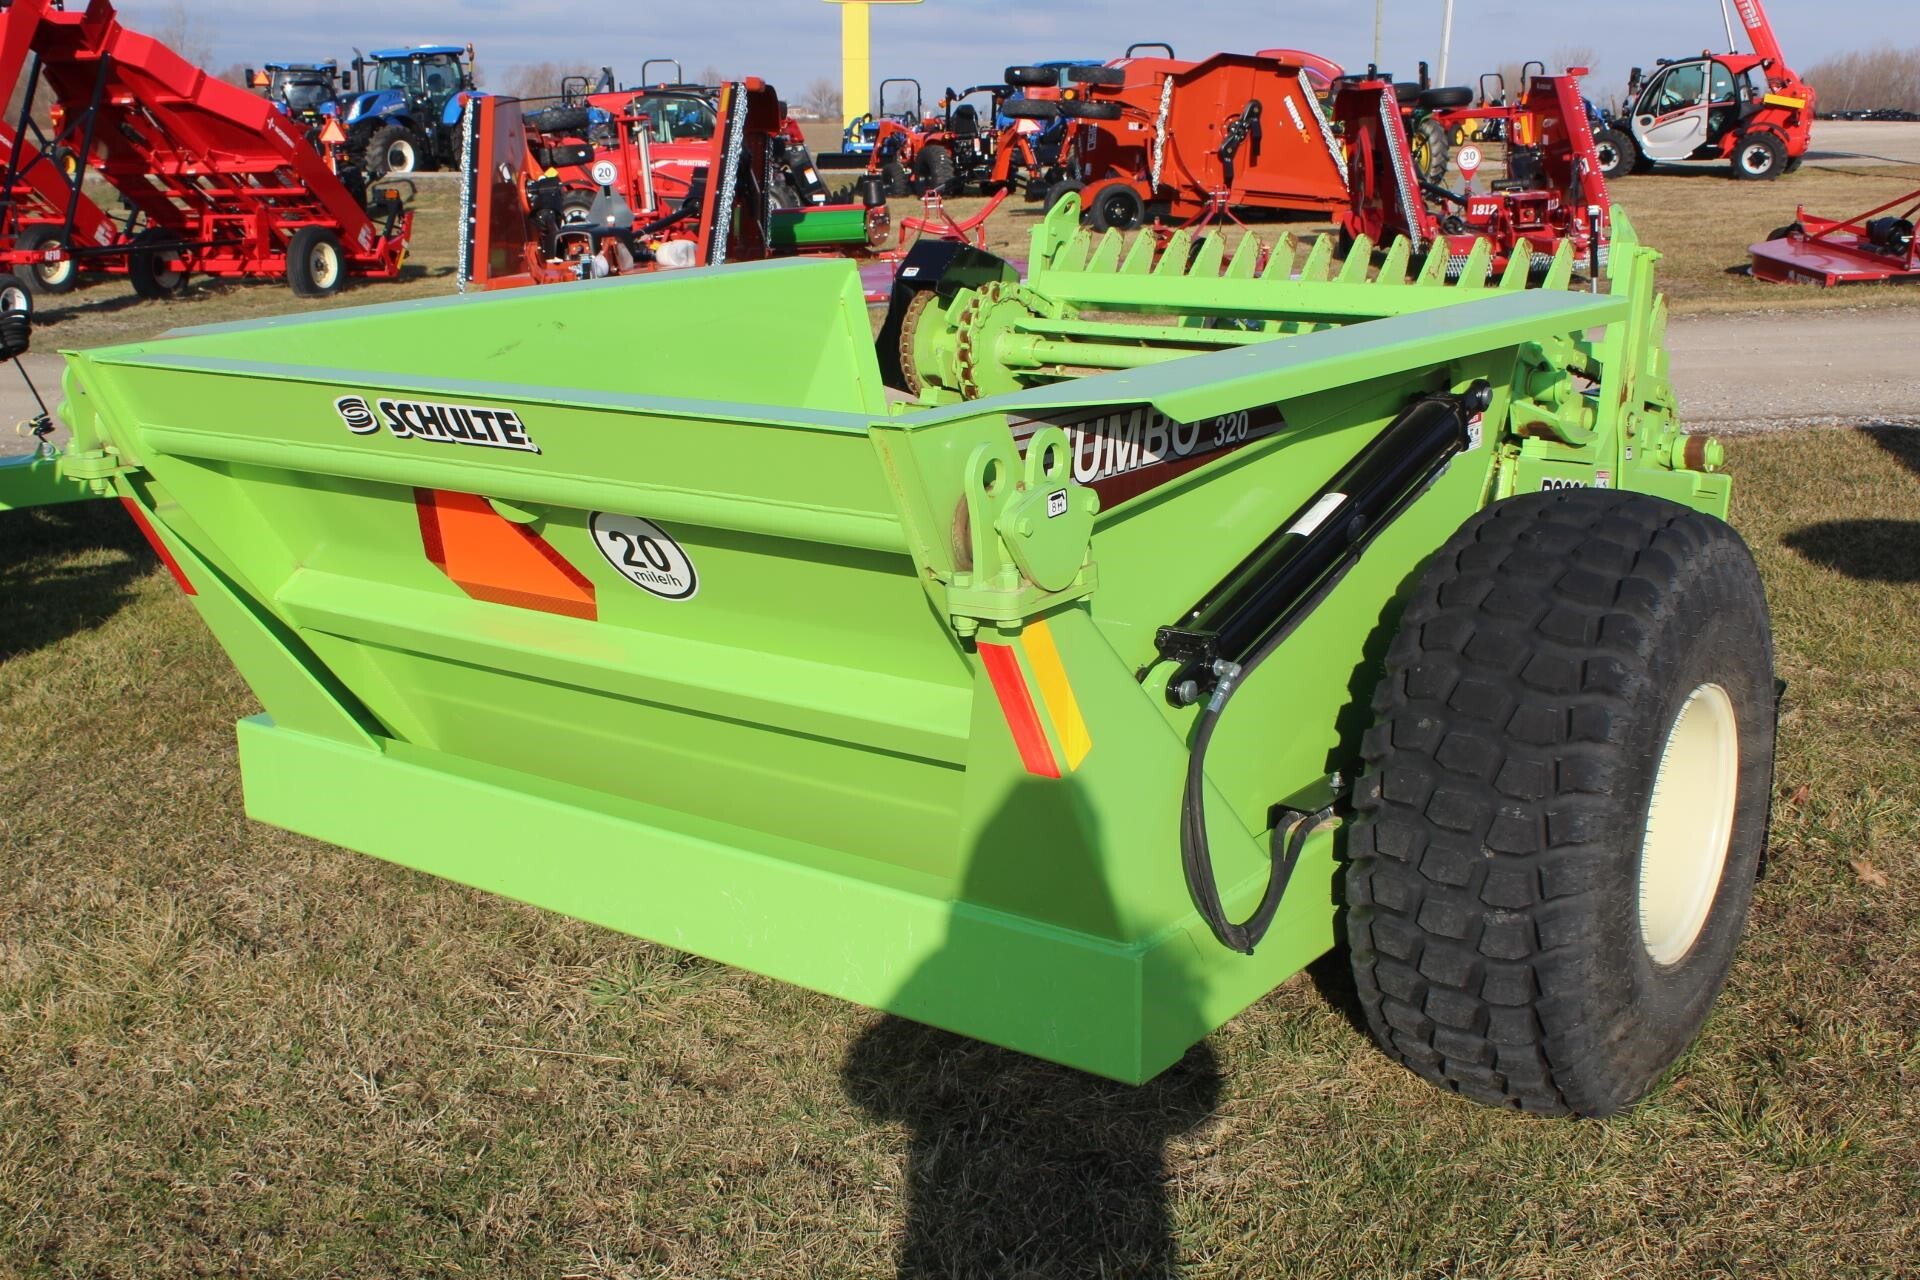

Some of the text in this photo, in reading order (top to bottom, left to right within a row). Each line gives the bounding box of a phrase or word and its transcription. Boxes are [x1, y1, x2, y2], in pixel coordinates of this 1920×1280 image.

[1463, 151, 1476, 161] 30
[598, 167, 611, 178] 20
[1472, 203, 1498, 216] 1812
[378, 400, 528, 446] SCHULTE
[1213, 409, 1249, 448] 320
[608, 530, 671, 573] 20
[634, 571, 683, 587] mile/h
